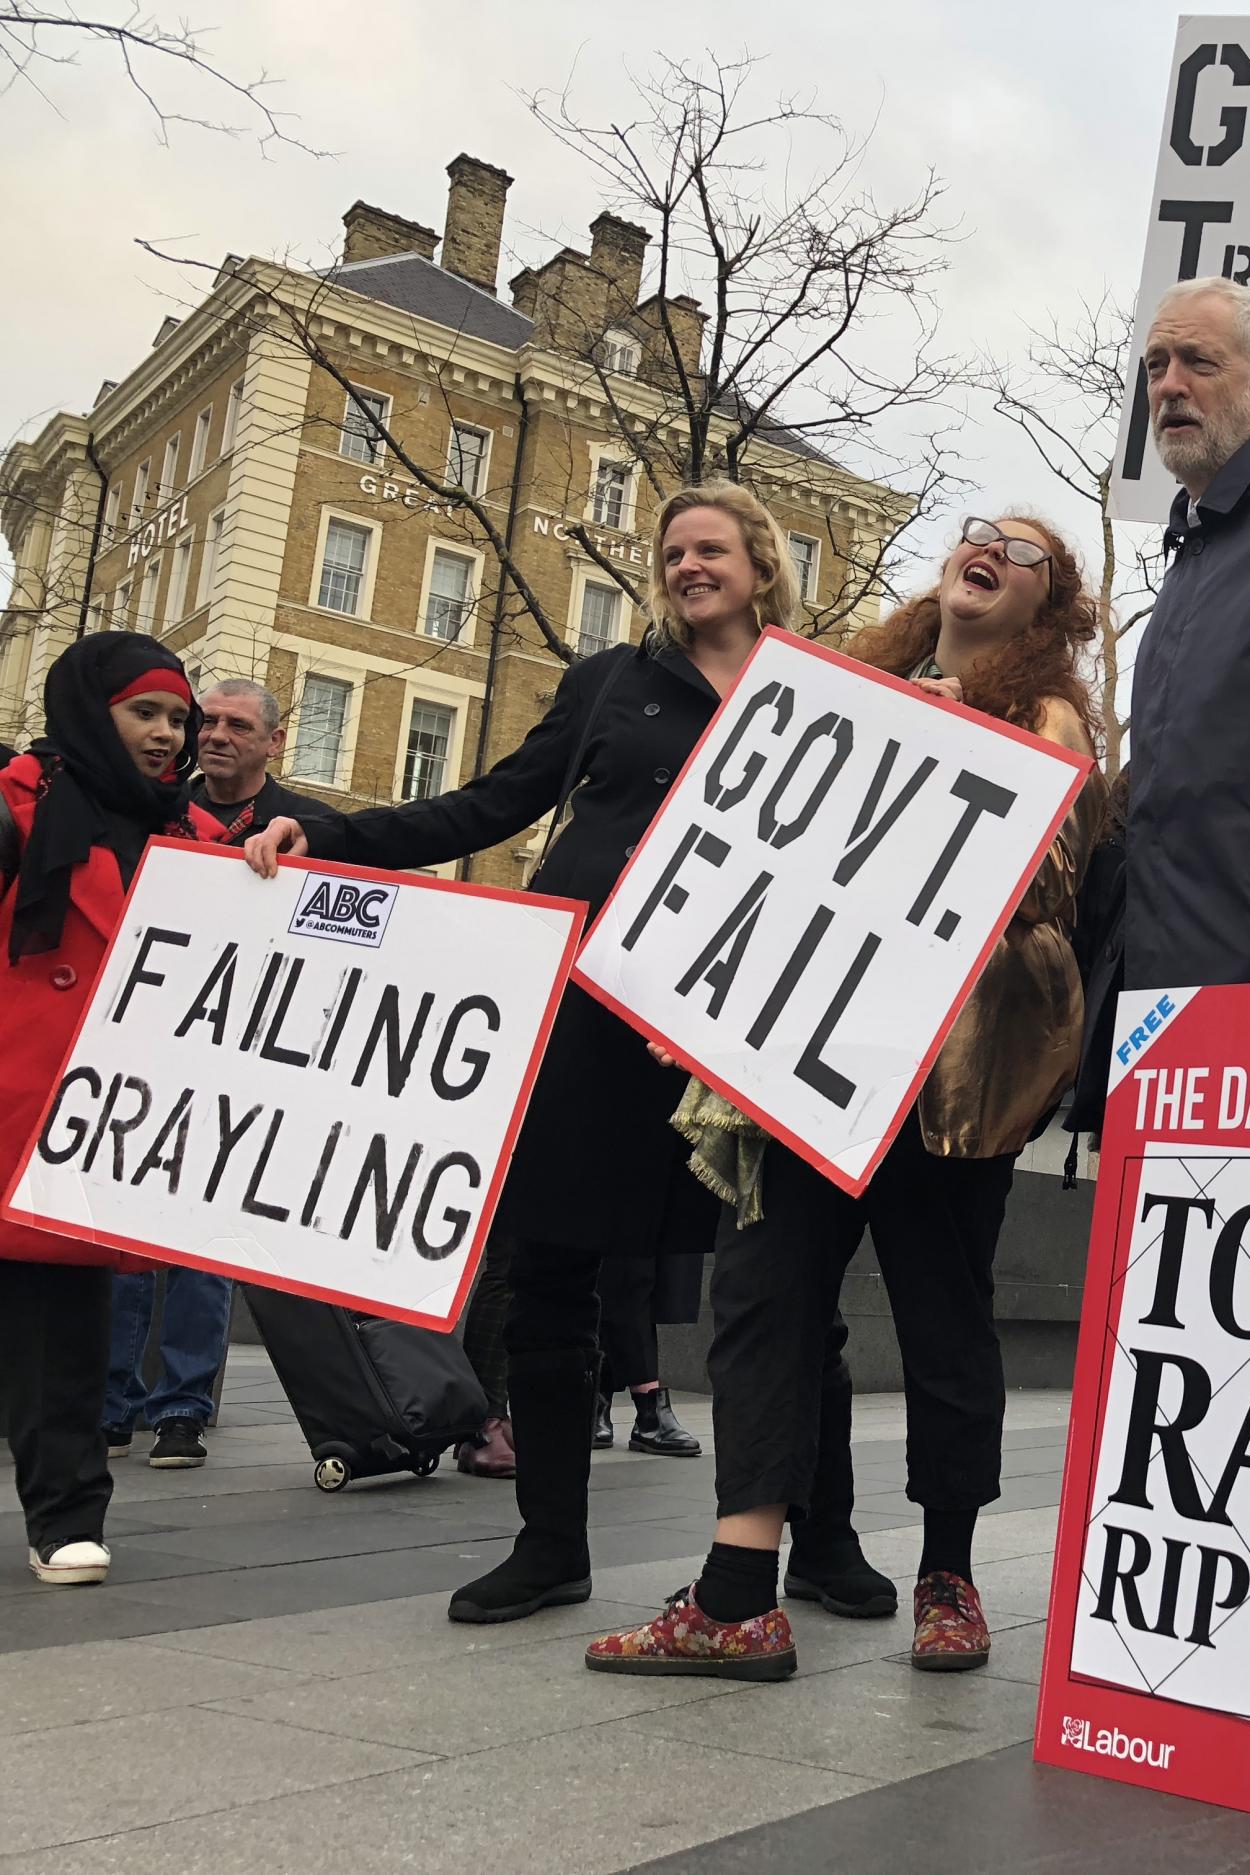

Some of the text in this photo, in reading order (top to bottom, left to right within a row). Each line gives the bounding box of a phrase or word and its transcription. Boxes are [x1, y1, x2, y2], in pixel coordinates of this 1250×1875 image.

[127, 496, 188, 568] HOTEL
[704, 680, 1018, 941] GOVT.
[300, 881, 389, 928] ABC
[306, 920, 377, 940] @ABCOMMUTERS
[621, 823, 882, 1110] FAIL
[112, 927, 500, 1100] FAILING
[1116, 994, 1175, 1066] FREE
[1133, 1066, 1210, 1130] THE
[37, 1066, 482, 1260] GRAYLING
[1089, 1524, 1250, 1649] RIP
[1082, 1728, 1175, 1769] Labour
